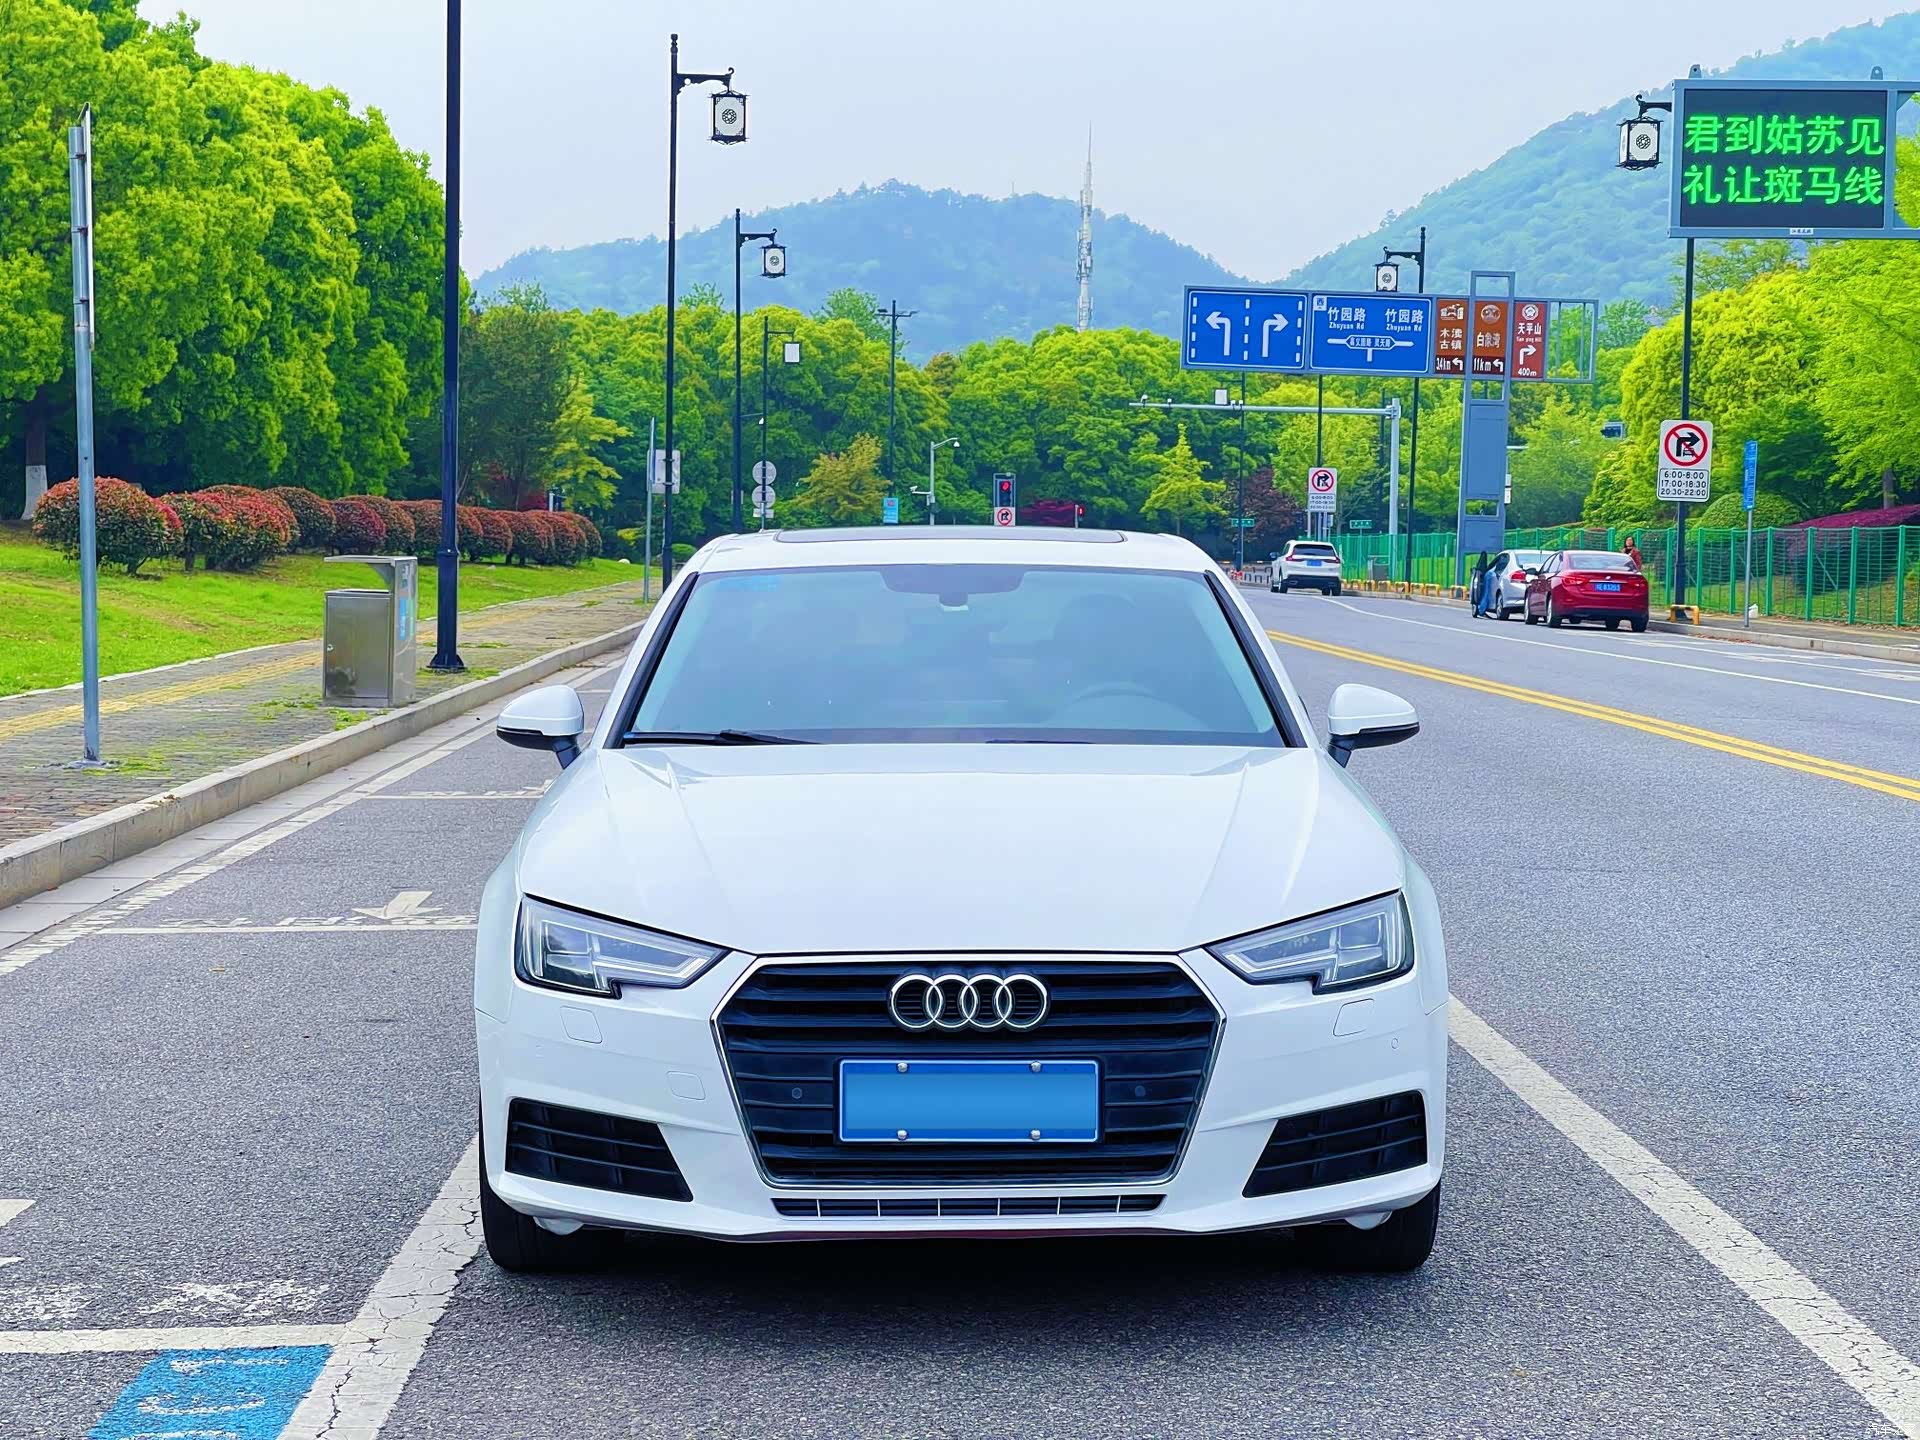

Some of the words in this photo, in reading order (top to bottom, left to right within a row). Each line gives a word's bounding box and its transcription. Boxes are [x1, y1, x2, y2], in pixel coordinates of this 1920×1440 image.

[1685, 115, 1884, 154] 君到姑苏见
[1683, 165, 1883, 204] 礼让斑马线
[1328, 307, 1366, 321] 竹园路
[1385, 308, 1424, 323] 竹园路
[1356, 322, 1365, 330] Rd
[1414, 324, 1422, 332] Rd
[1517, 322, 1542, 334] 天平山
